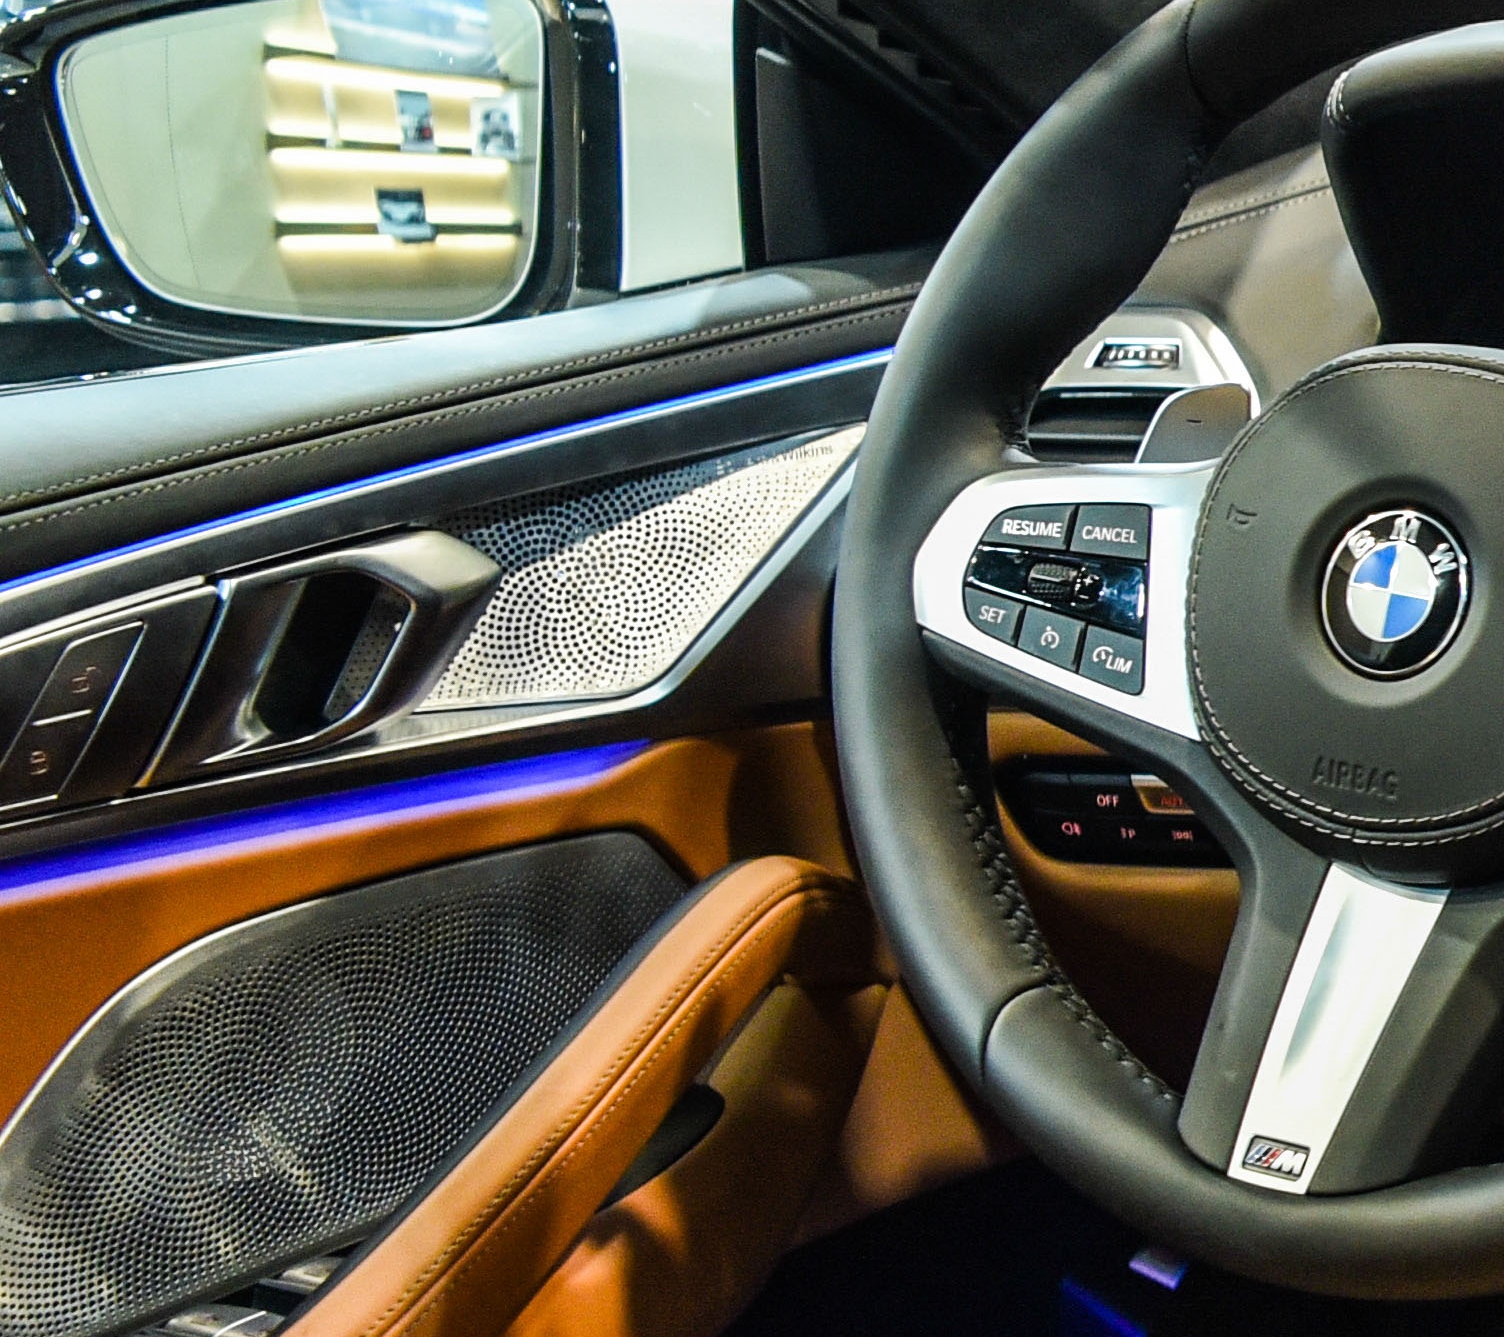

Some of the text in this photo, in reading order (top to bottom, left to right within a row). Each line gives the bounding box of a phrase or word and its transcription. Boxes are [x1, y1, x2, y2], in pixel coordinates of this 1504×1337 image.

[1002, 519, 1063, 538] RESUME
[1082, 525, 1138, 544] CANCEL
[1347, 514, 1458, 576] BMW
[978, 605, 1007, 625] SET
[1105, 655, 1133, 674] LIM
[1311, 754, 1398, 800] AIRBAG
[1096, 794, 1120, 808] OFF
